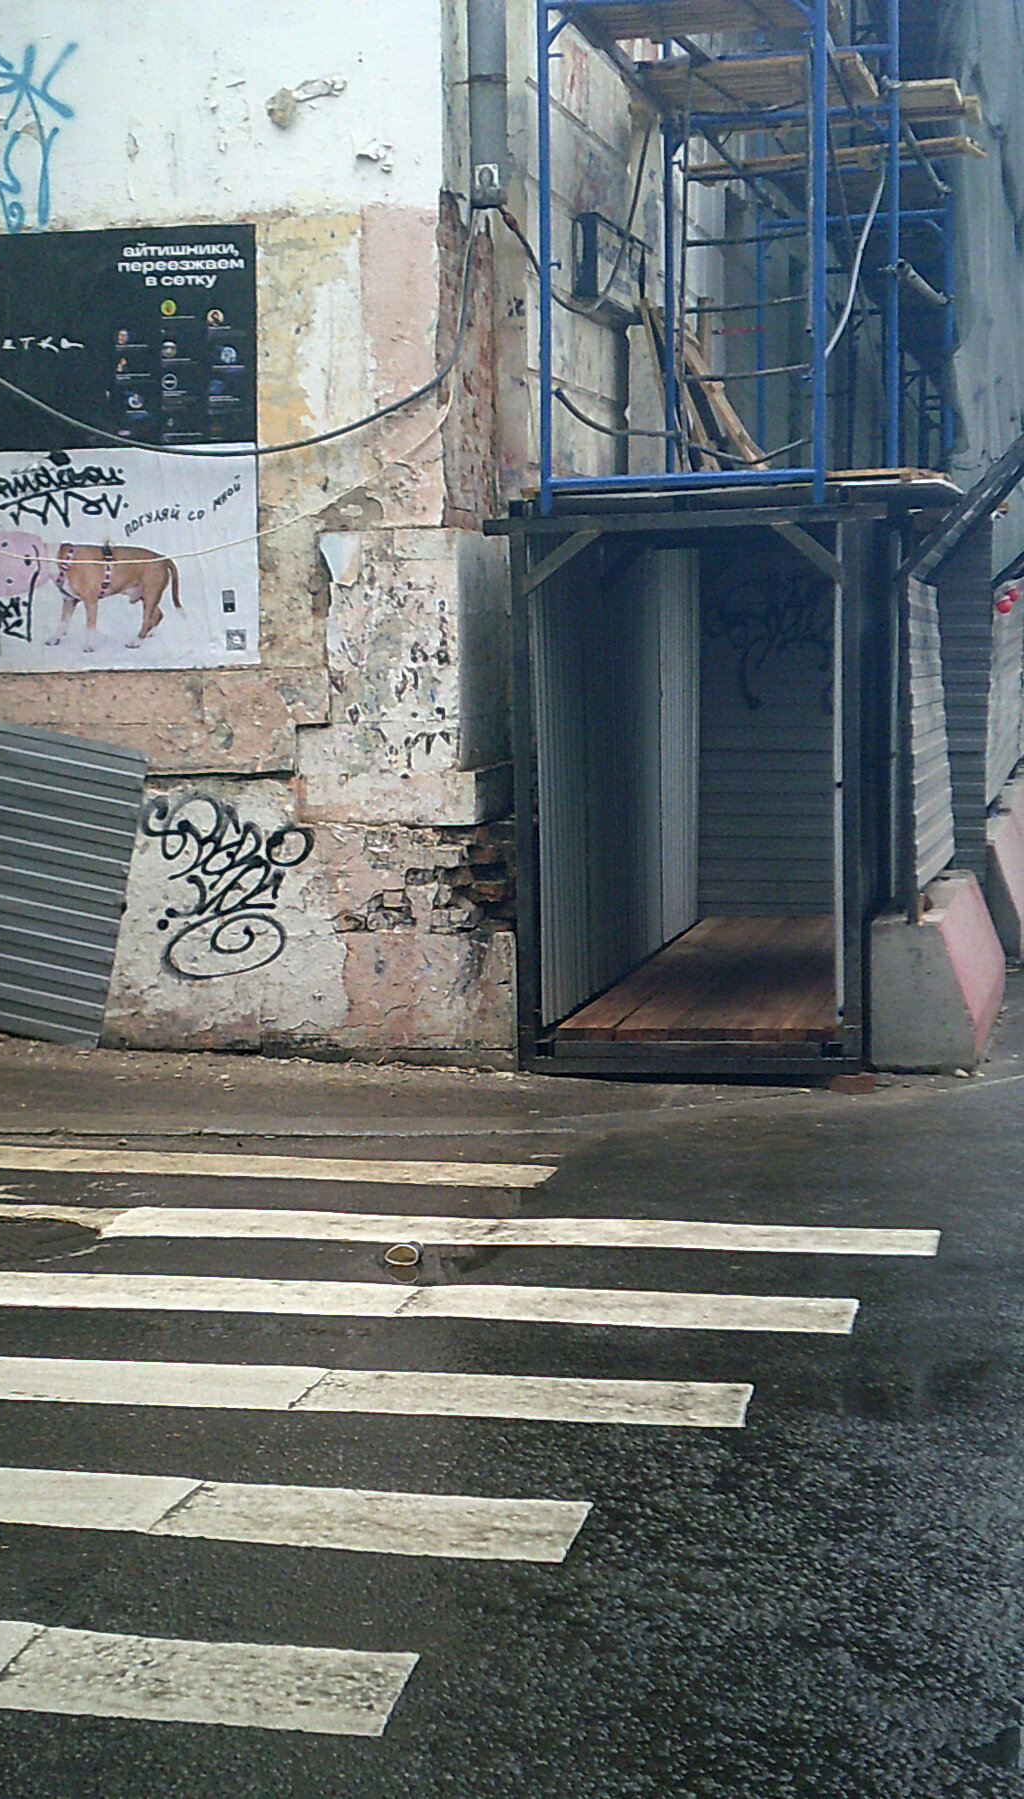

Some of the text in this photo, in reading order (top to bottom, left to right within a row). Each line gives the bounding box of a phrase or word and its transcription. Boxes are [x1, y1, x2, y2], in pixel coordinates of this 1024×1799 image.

[122, 242, 240, 258] айтишники,
[117, 258, 245, 275] переезжаем
[144, 274, 218, 289] в сетку
